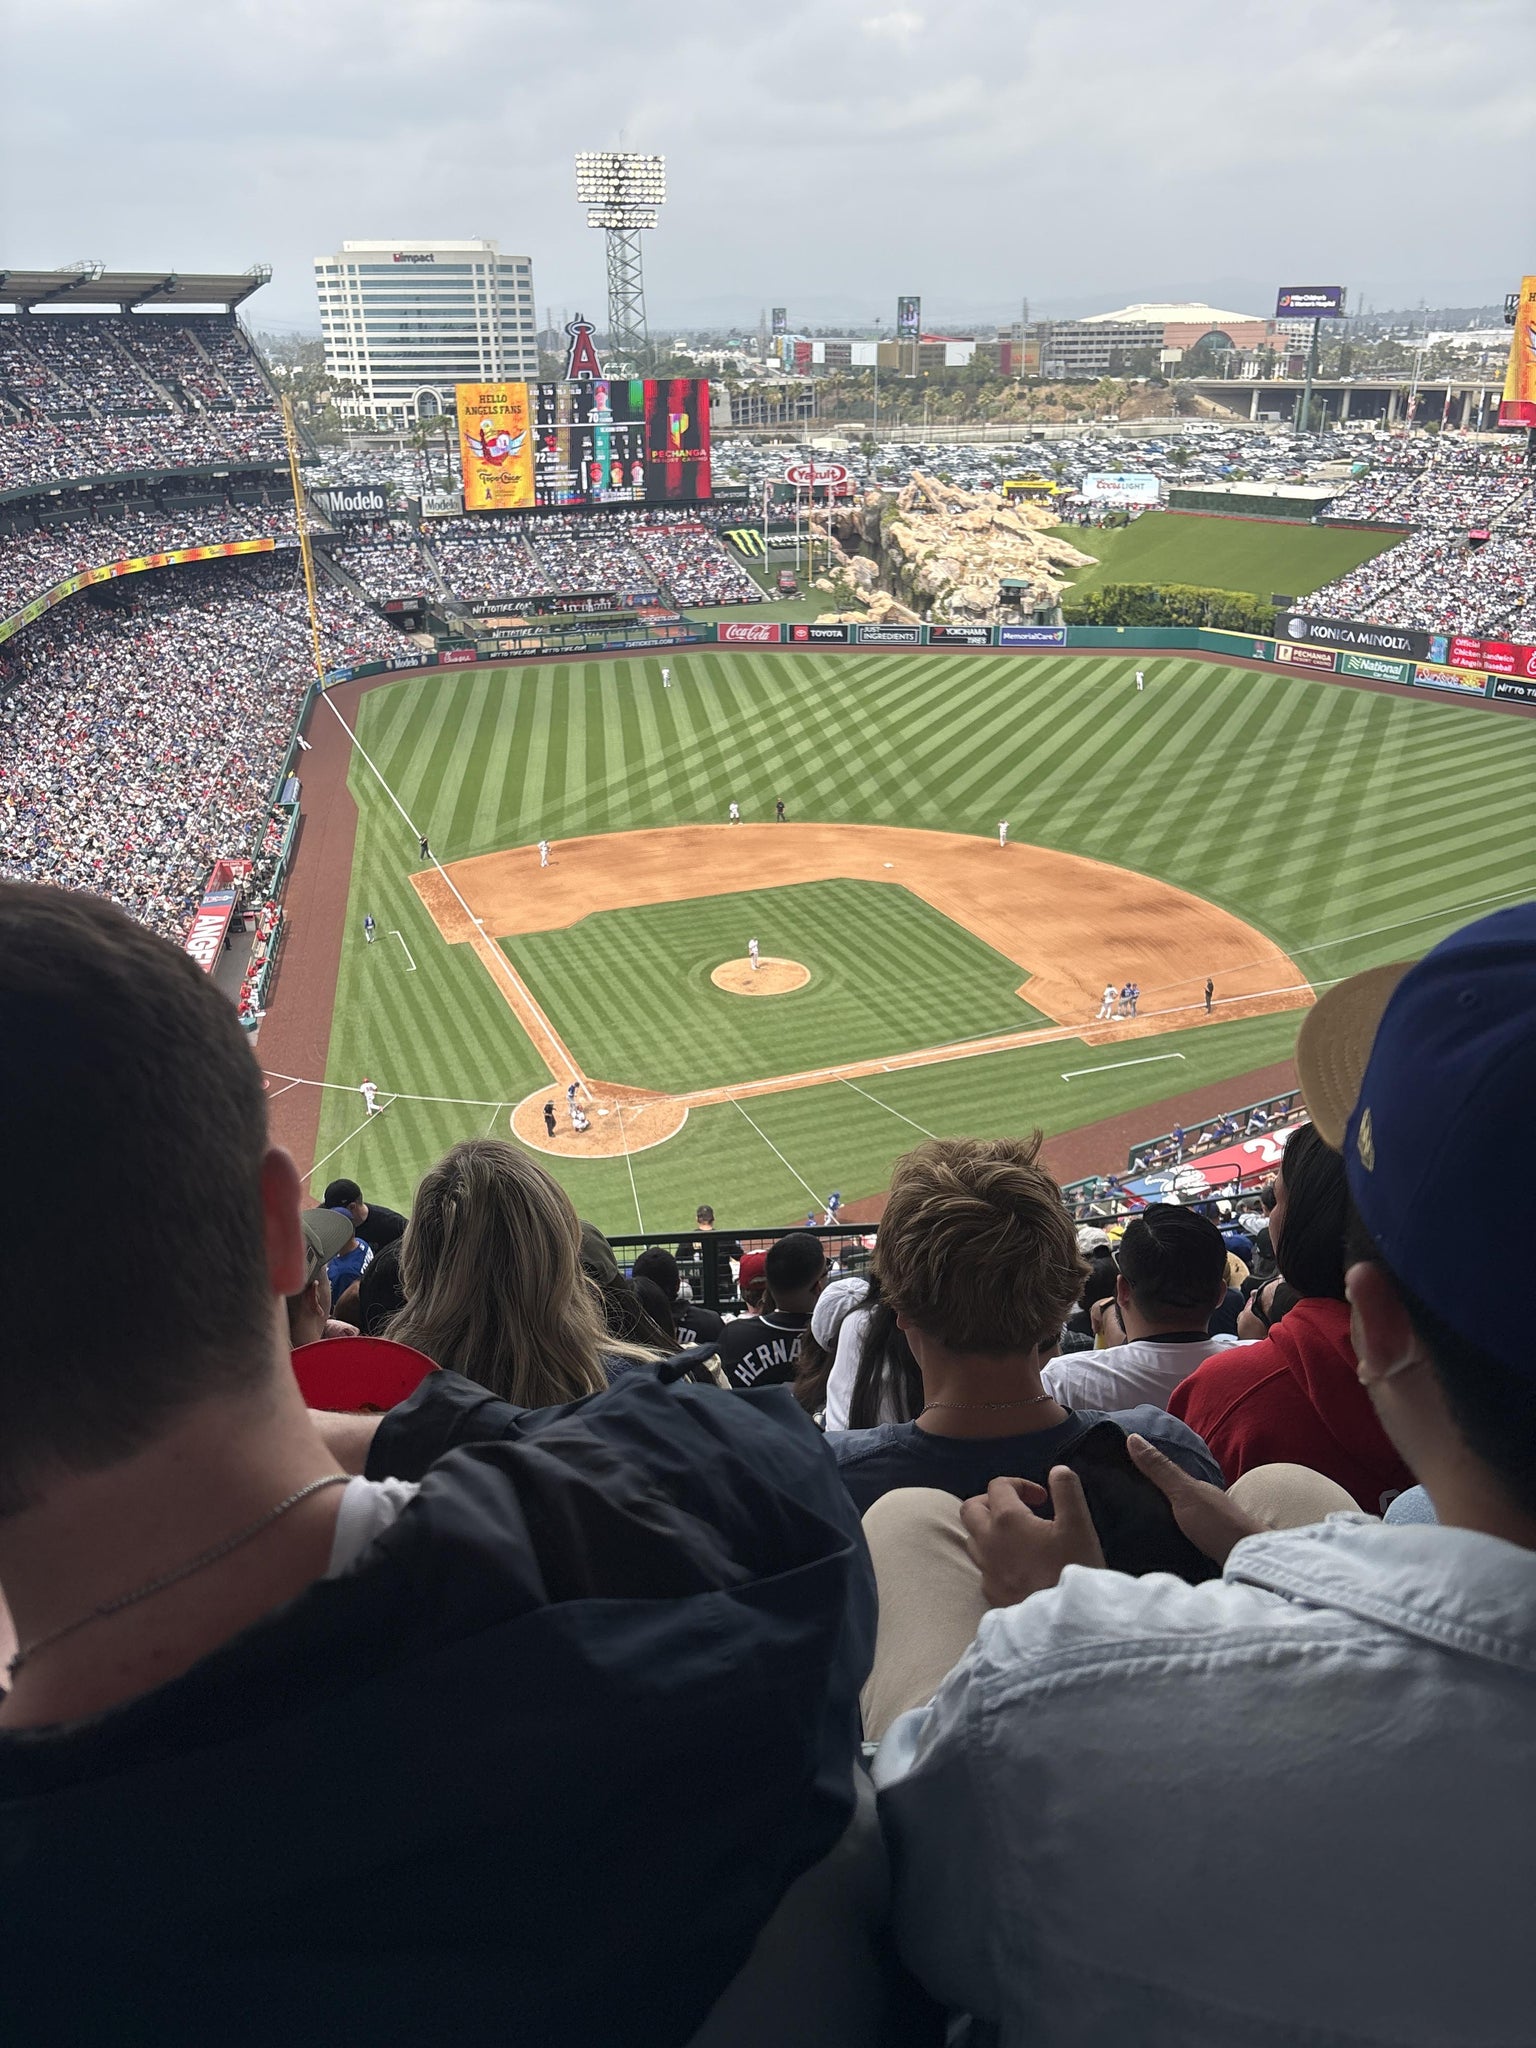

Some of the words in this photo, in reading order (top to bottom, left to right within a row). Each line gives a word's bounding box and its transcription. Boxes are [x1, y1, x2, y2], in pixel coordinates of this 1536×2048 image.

[479, 394, 507, 404] HELLO
[465, 406, 498, 415] ANGELS
[500, 405, 521, 414] FANS
[651, 449, 707, 458] PECHANGA
[1096, 480, 1122, 490] Coors
[329, 490, 384, 512] Modelo
[426, 498, 458, 511] Modelo
[810, 629, 844, 637] TOYOTA
[945, 628, 988, 636] YOKOHAMA
[1003, 632, 1053, 640] MemorialCare
[1310, 625, 1355, 643] KONICA
[1357, 634, 1412, 651] MINOLTA
[1455, 638, 1480, 648] Official
[1293, 649, 1332, 661] PECHANGA
[1453, 648, 1481, 658] Chicken
[1482, 652, 1515, 663] Sandwich
[395, 658, 419, 669] Modelo
[1360, 657, 1403, 675] National
[1460, 658, 1482, 668] Angels
[1483, 661, 1513, 672] Baseball
[1497, 683, 1525, 694] NITTO
